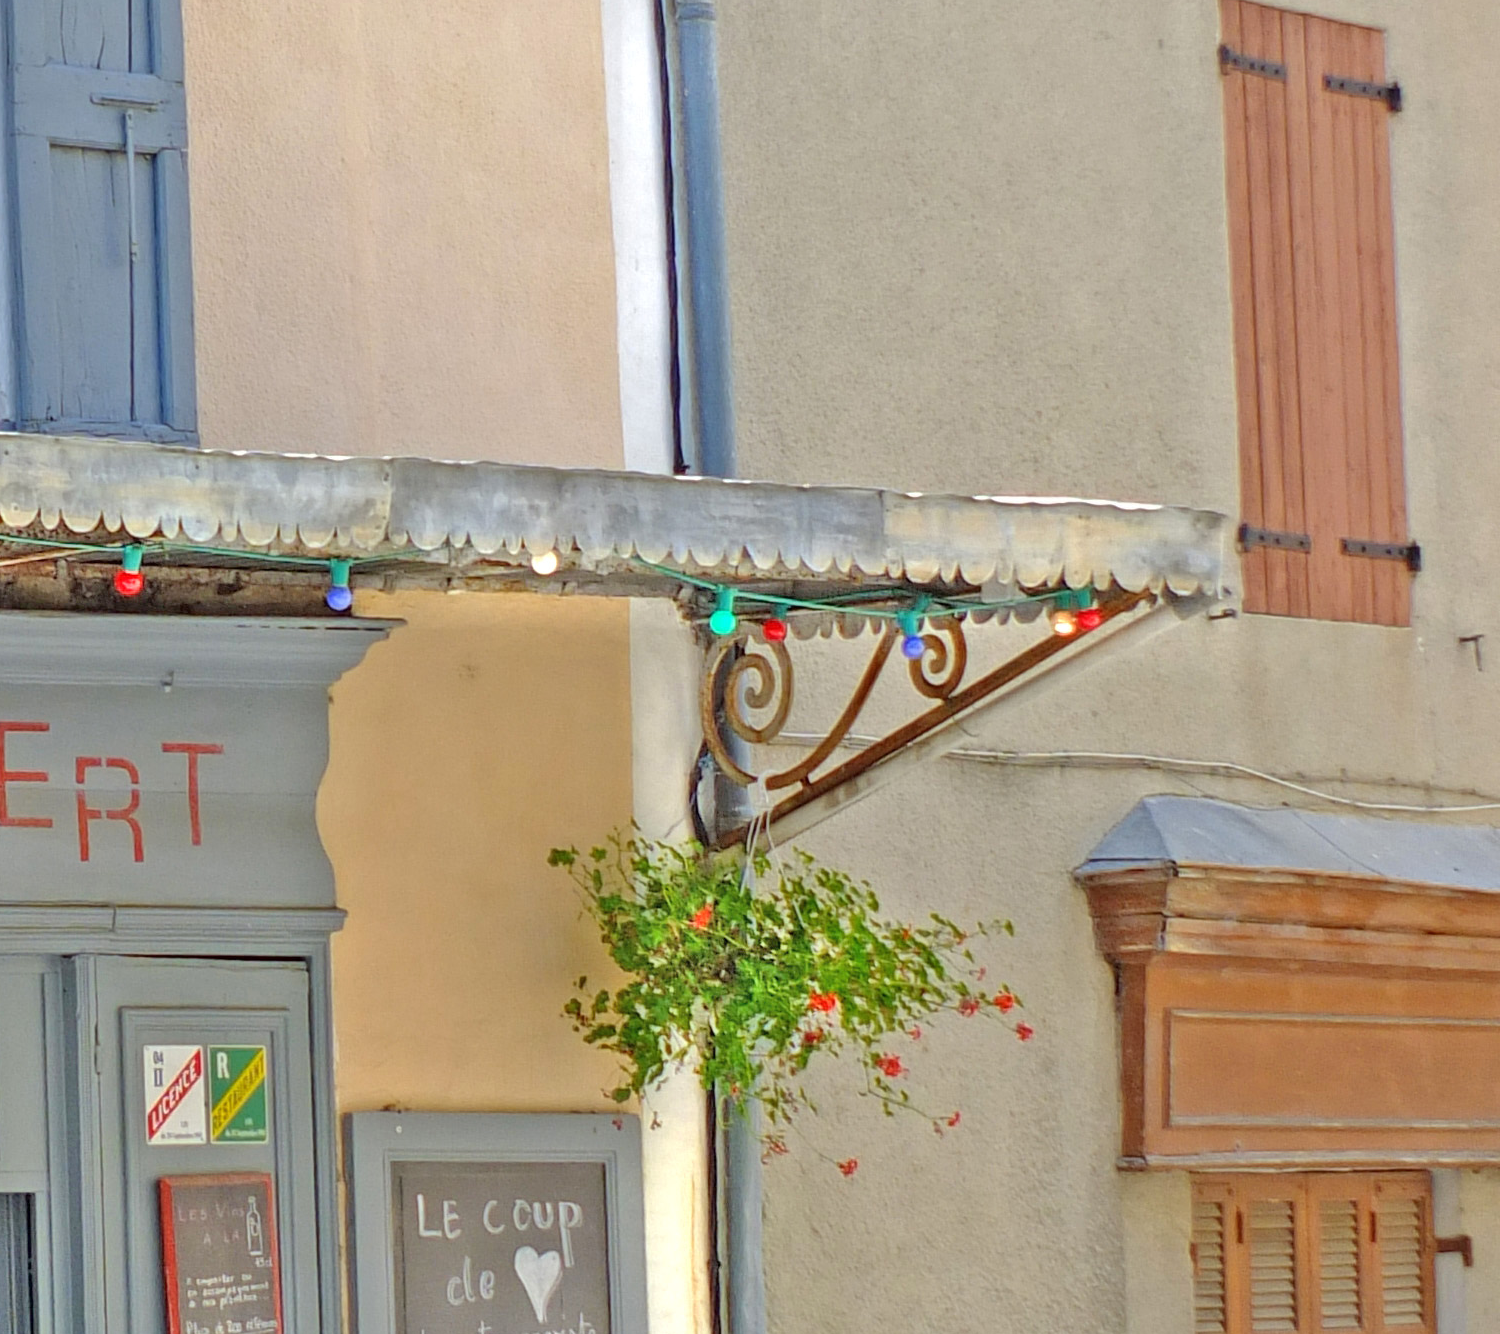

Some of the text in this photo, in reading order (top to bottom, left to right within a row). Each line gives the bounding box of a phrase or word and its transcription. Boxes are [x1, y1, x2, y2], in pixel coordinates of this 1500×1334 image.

[216, 1051, 230, 1079] R
[150, 1056, 198, 1133] LICENCE
[211, 1053, 265, 1136] RESTAURANT
[416, 1193, 463, 1239] LE
[446, 1254, 495, 1306] de
